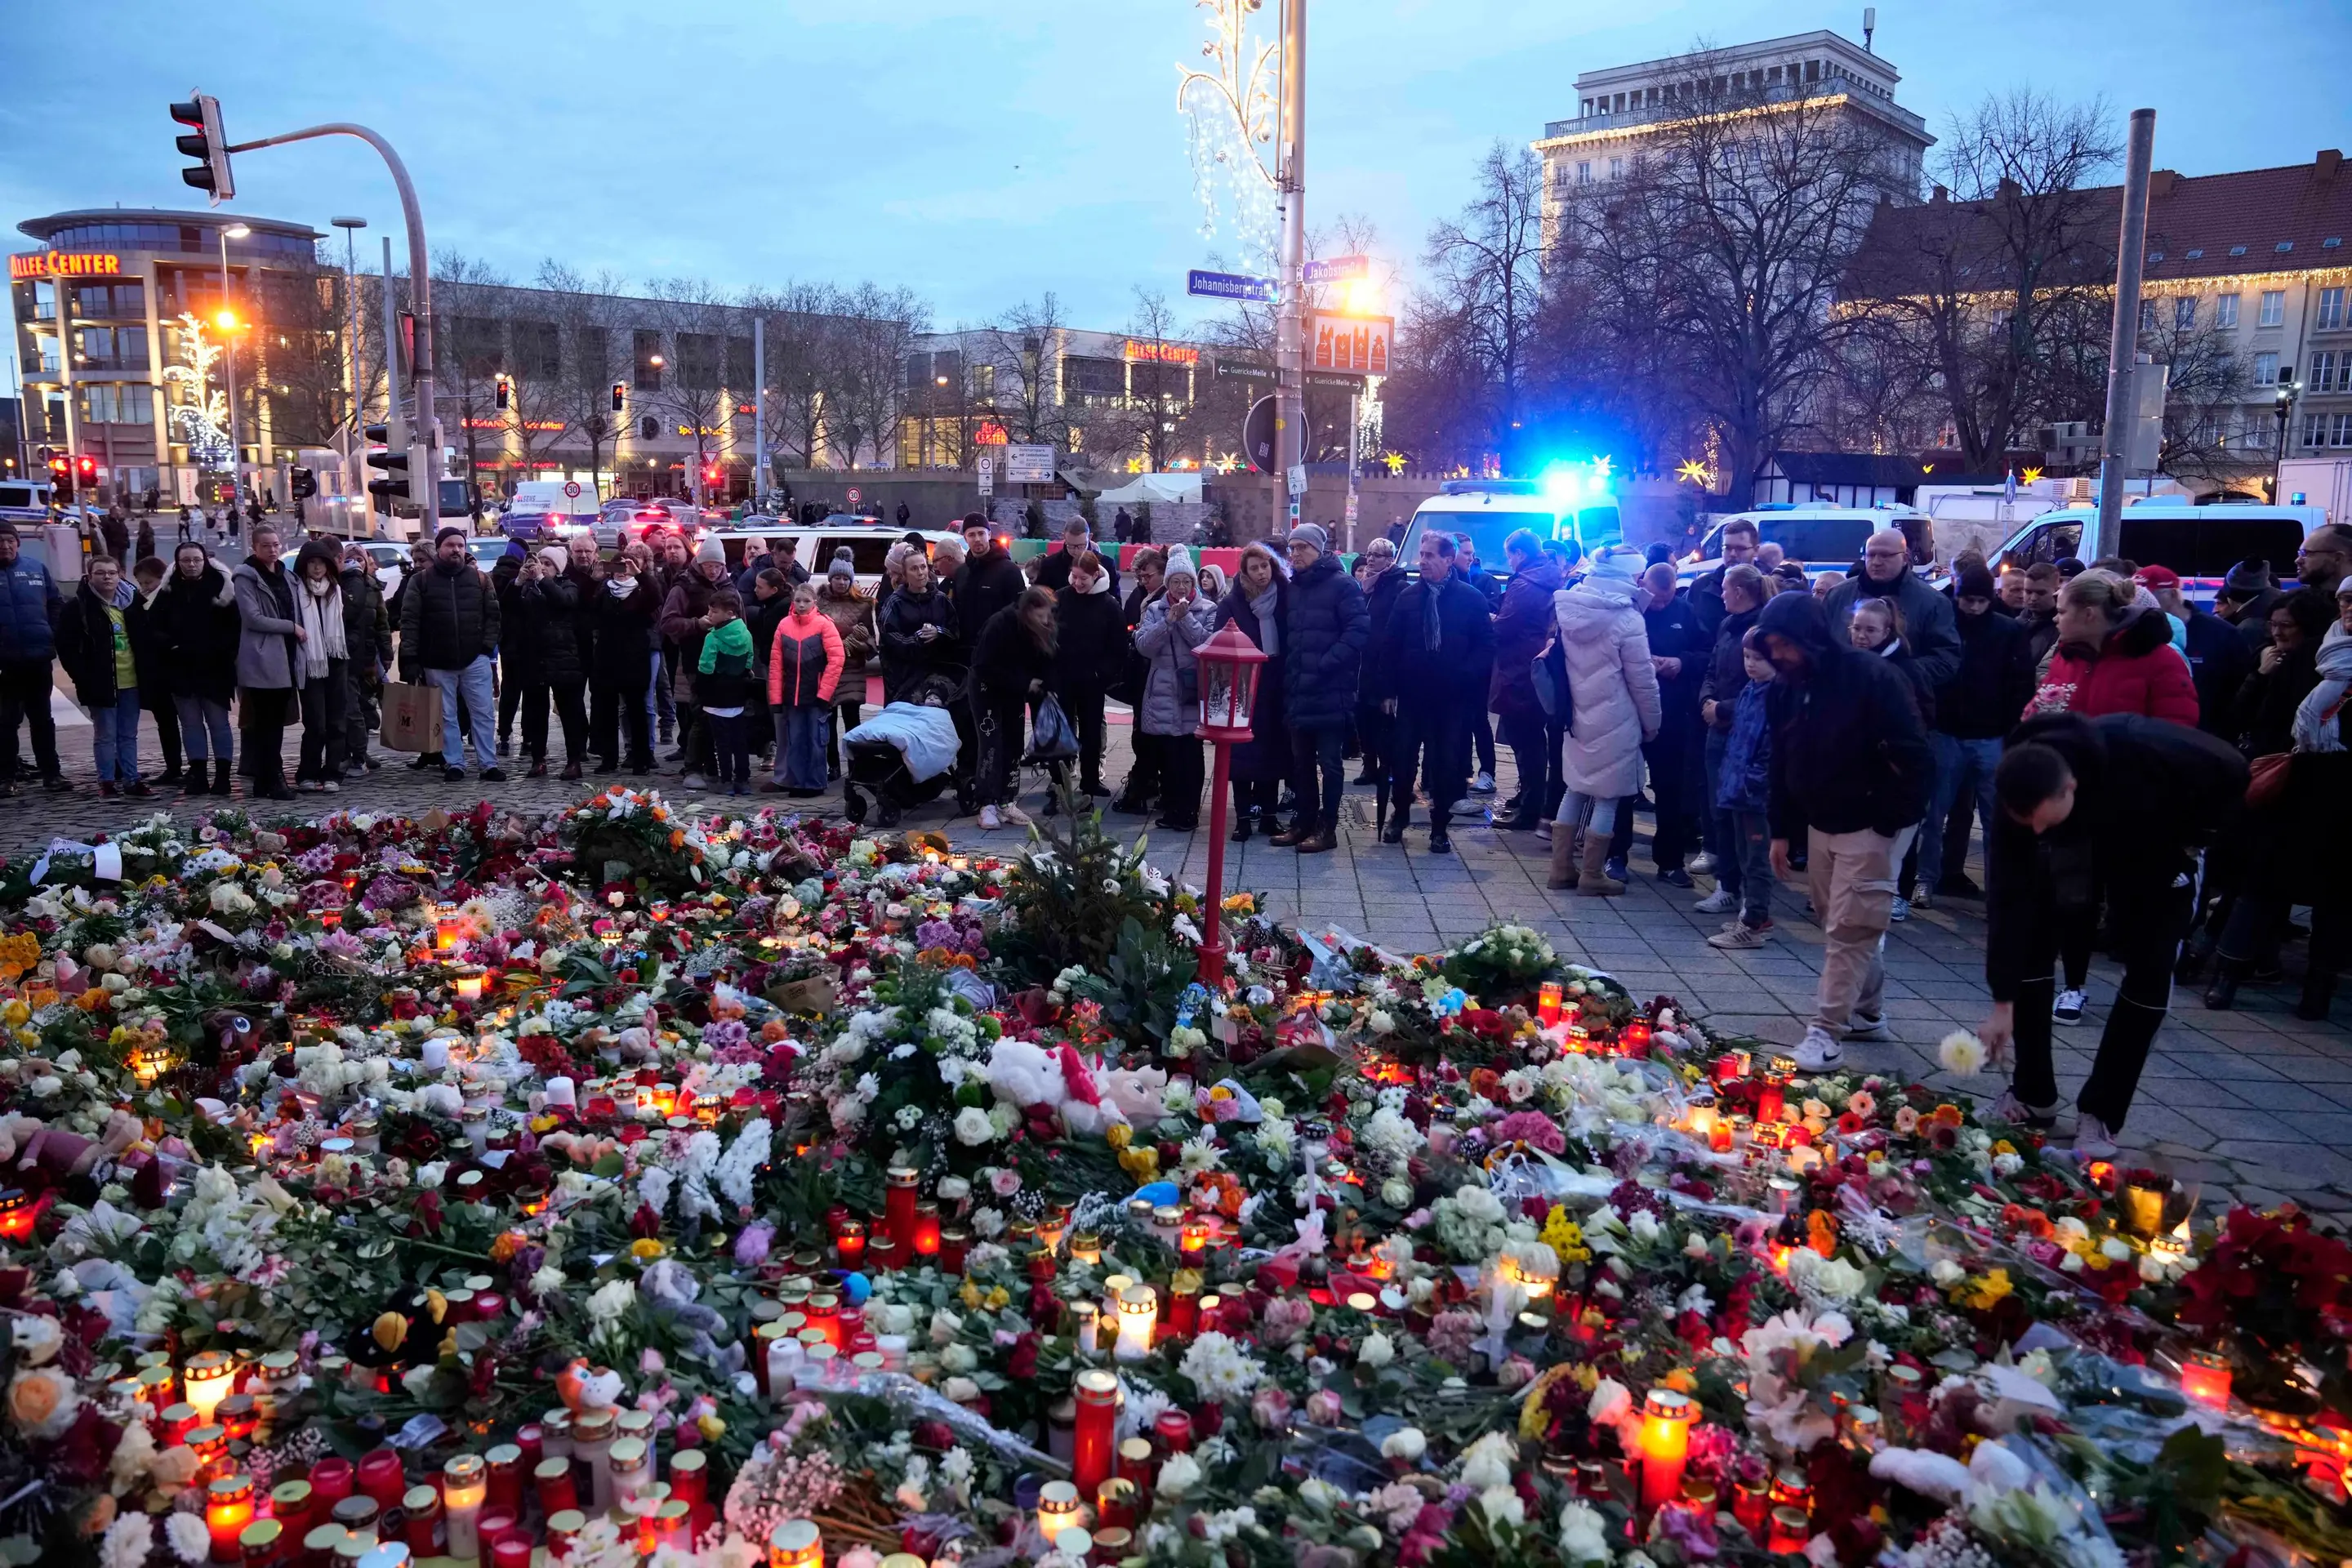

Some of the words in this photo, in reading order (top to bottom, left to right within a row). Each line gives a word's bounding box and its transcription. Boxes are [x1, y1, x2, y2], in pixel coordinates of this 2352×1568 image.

[11, 250, 120, 278] ALLEE-CENTER
[1309, 261, 1358, 279] Jakobstrß
[1231, 367, 1267, 377] GuerickeMeile
[1314, 377, 1350, 386] GuerickeMeile
[568, 486, 577, 494] 30
